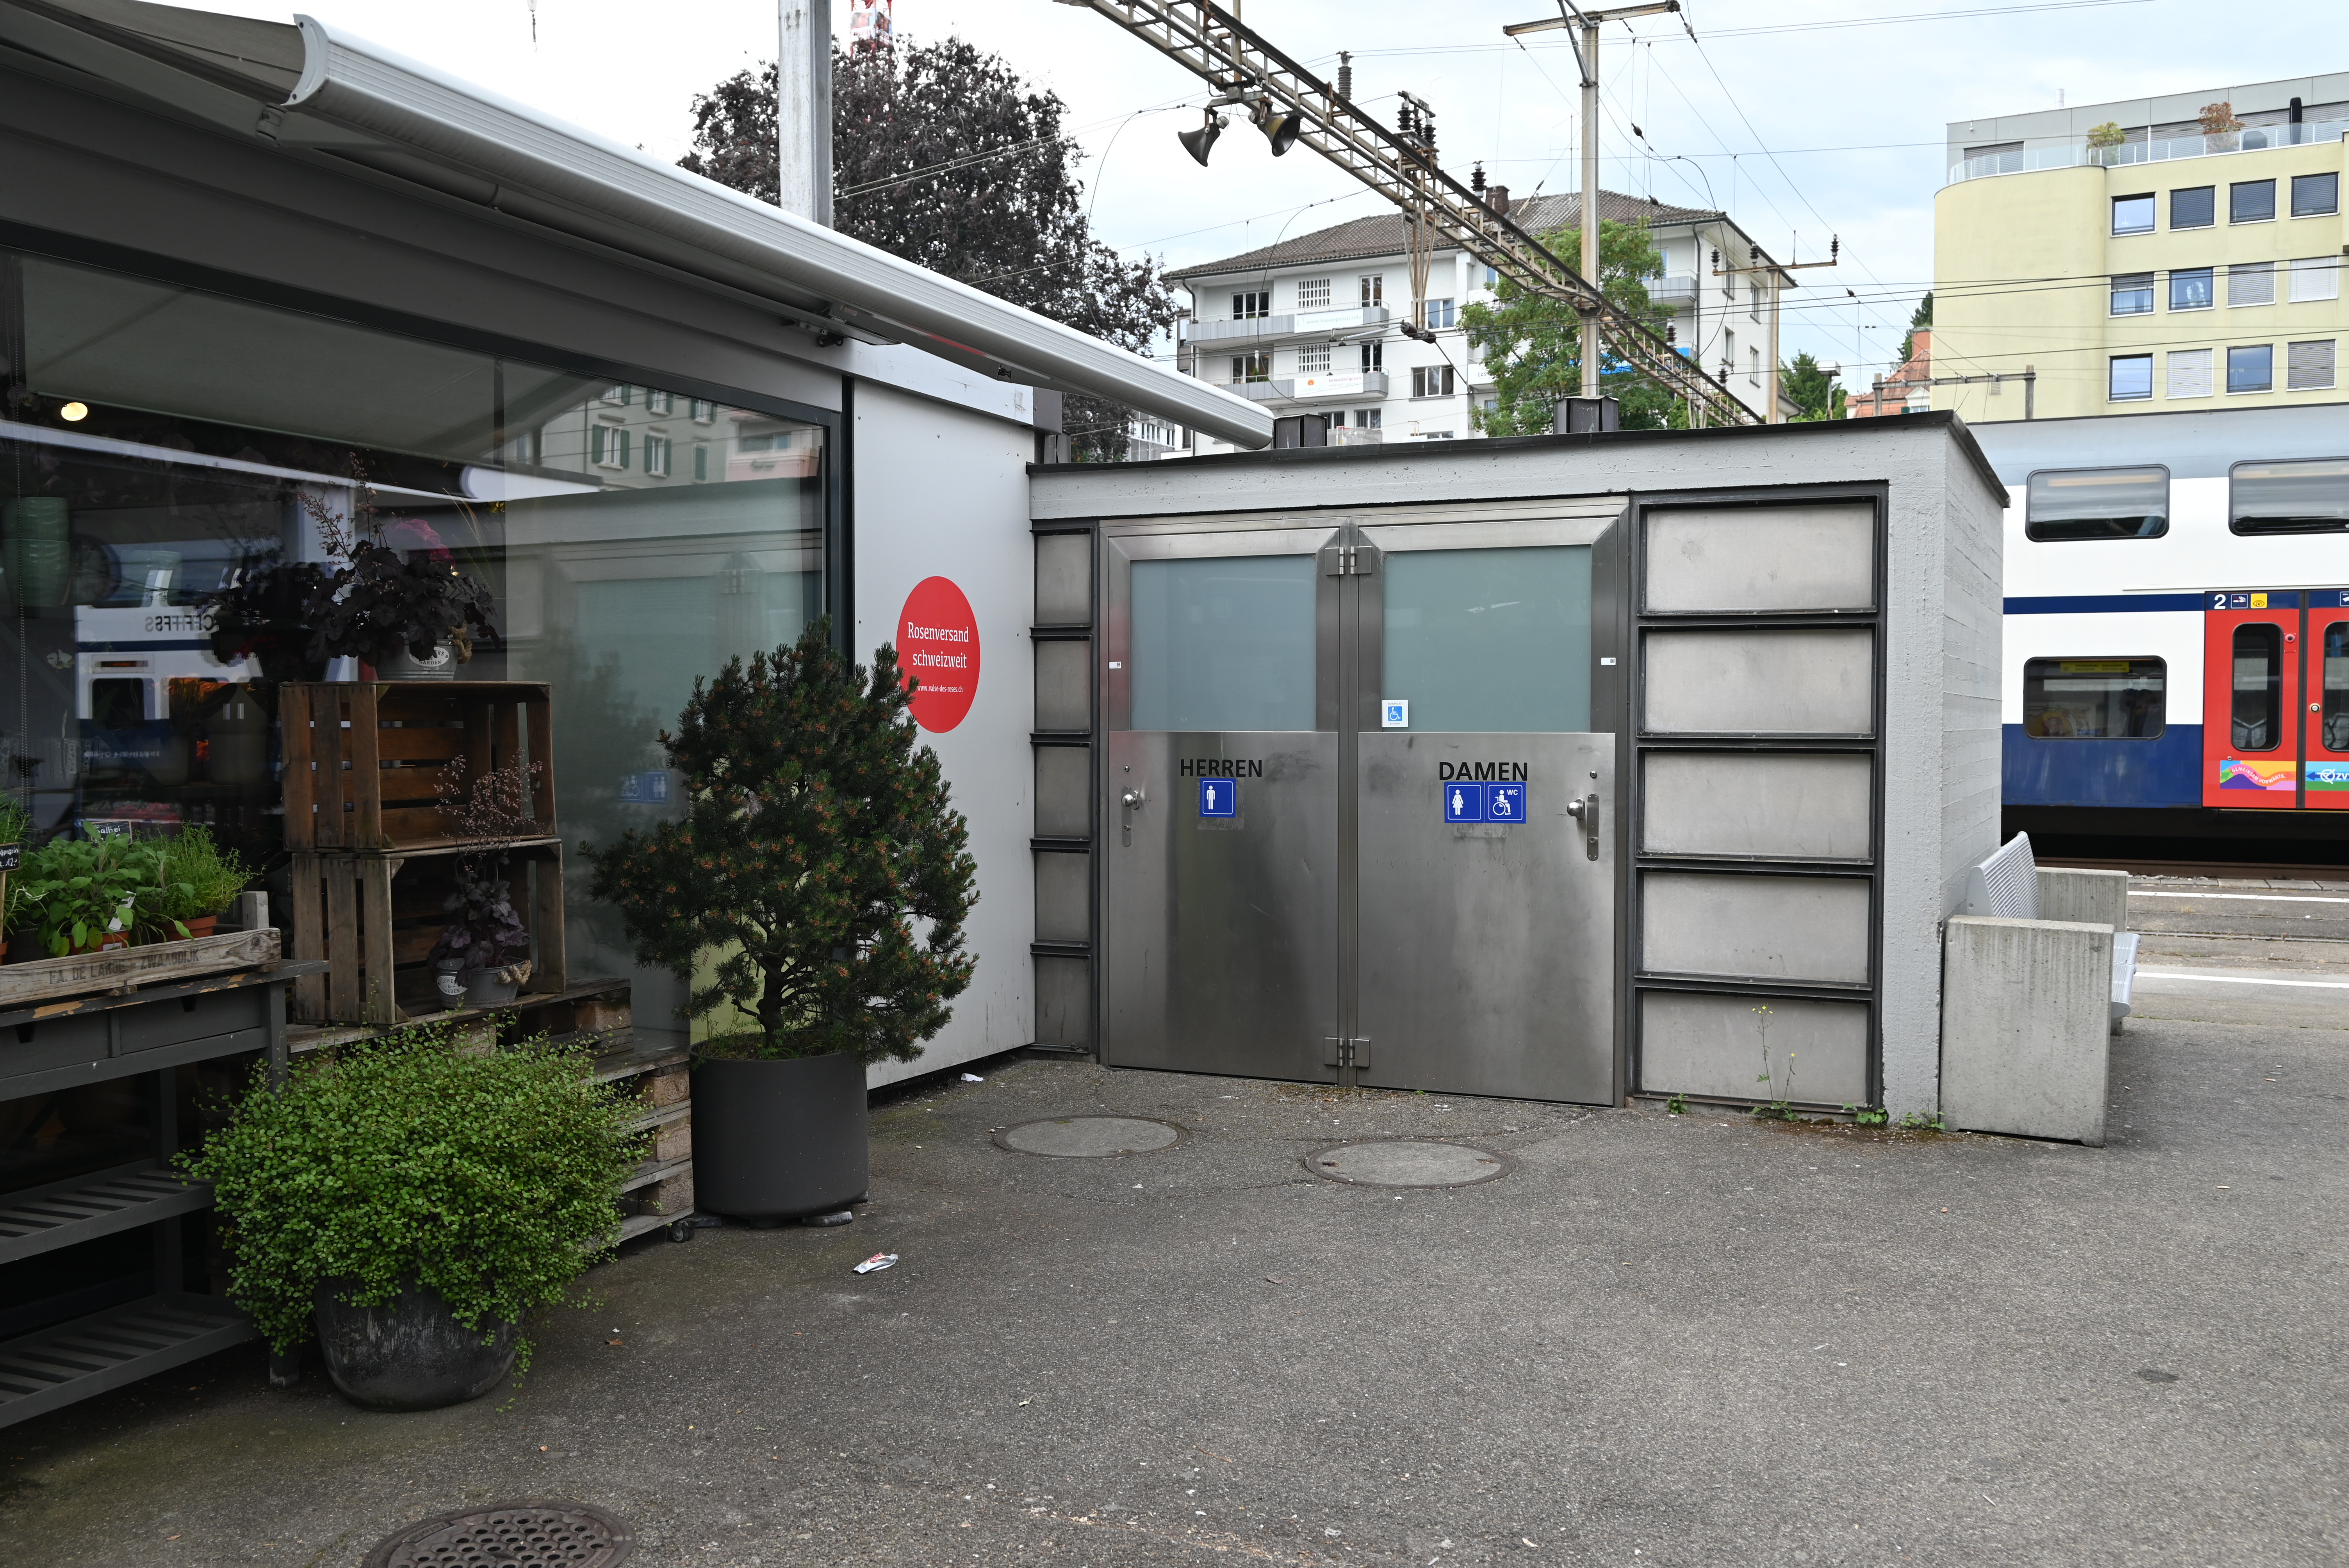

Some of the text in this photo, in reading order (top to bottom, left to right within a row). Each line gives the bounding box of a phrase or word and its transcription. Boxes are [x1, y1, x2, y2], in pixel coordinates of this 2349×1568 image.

[1307, 315, 1362, 324] www.frauenpraxis.info
[2214, 594, 2226, 609] 2
[908, 622, 969, 643] Rosenversand
[913, 649, 967, 668] schweizweit
[917, 684, 963, 693] www.valse-des-roses.ch
[1180, 759, 1262, 777] HERREN
[1439, 762, 1528, 781] DAMEN
[2231, 766, 2259, 781] GEMEINSAM
[0, 846, 18, 857] smarin
[72, 965, 86, 981] DE
